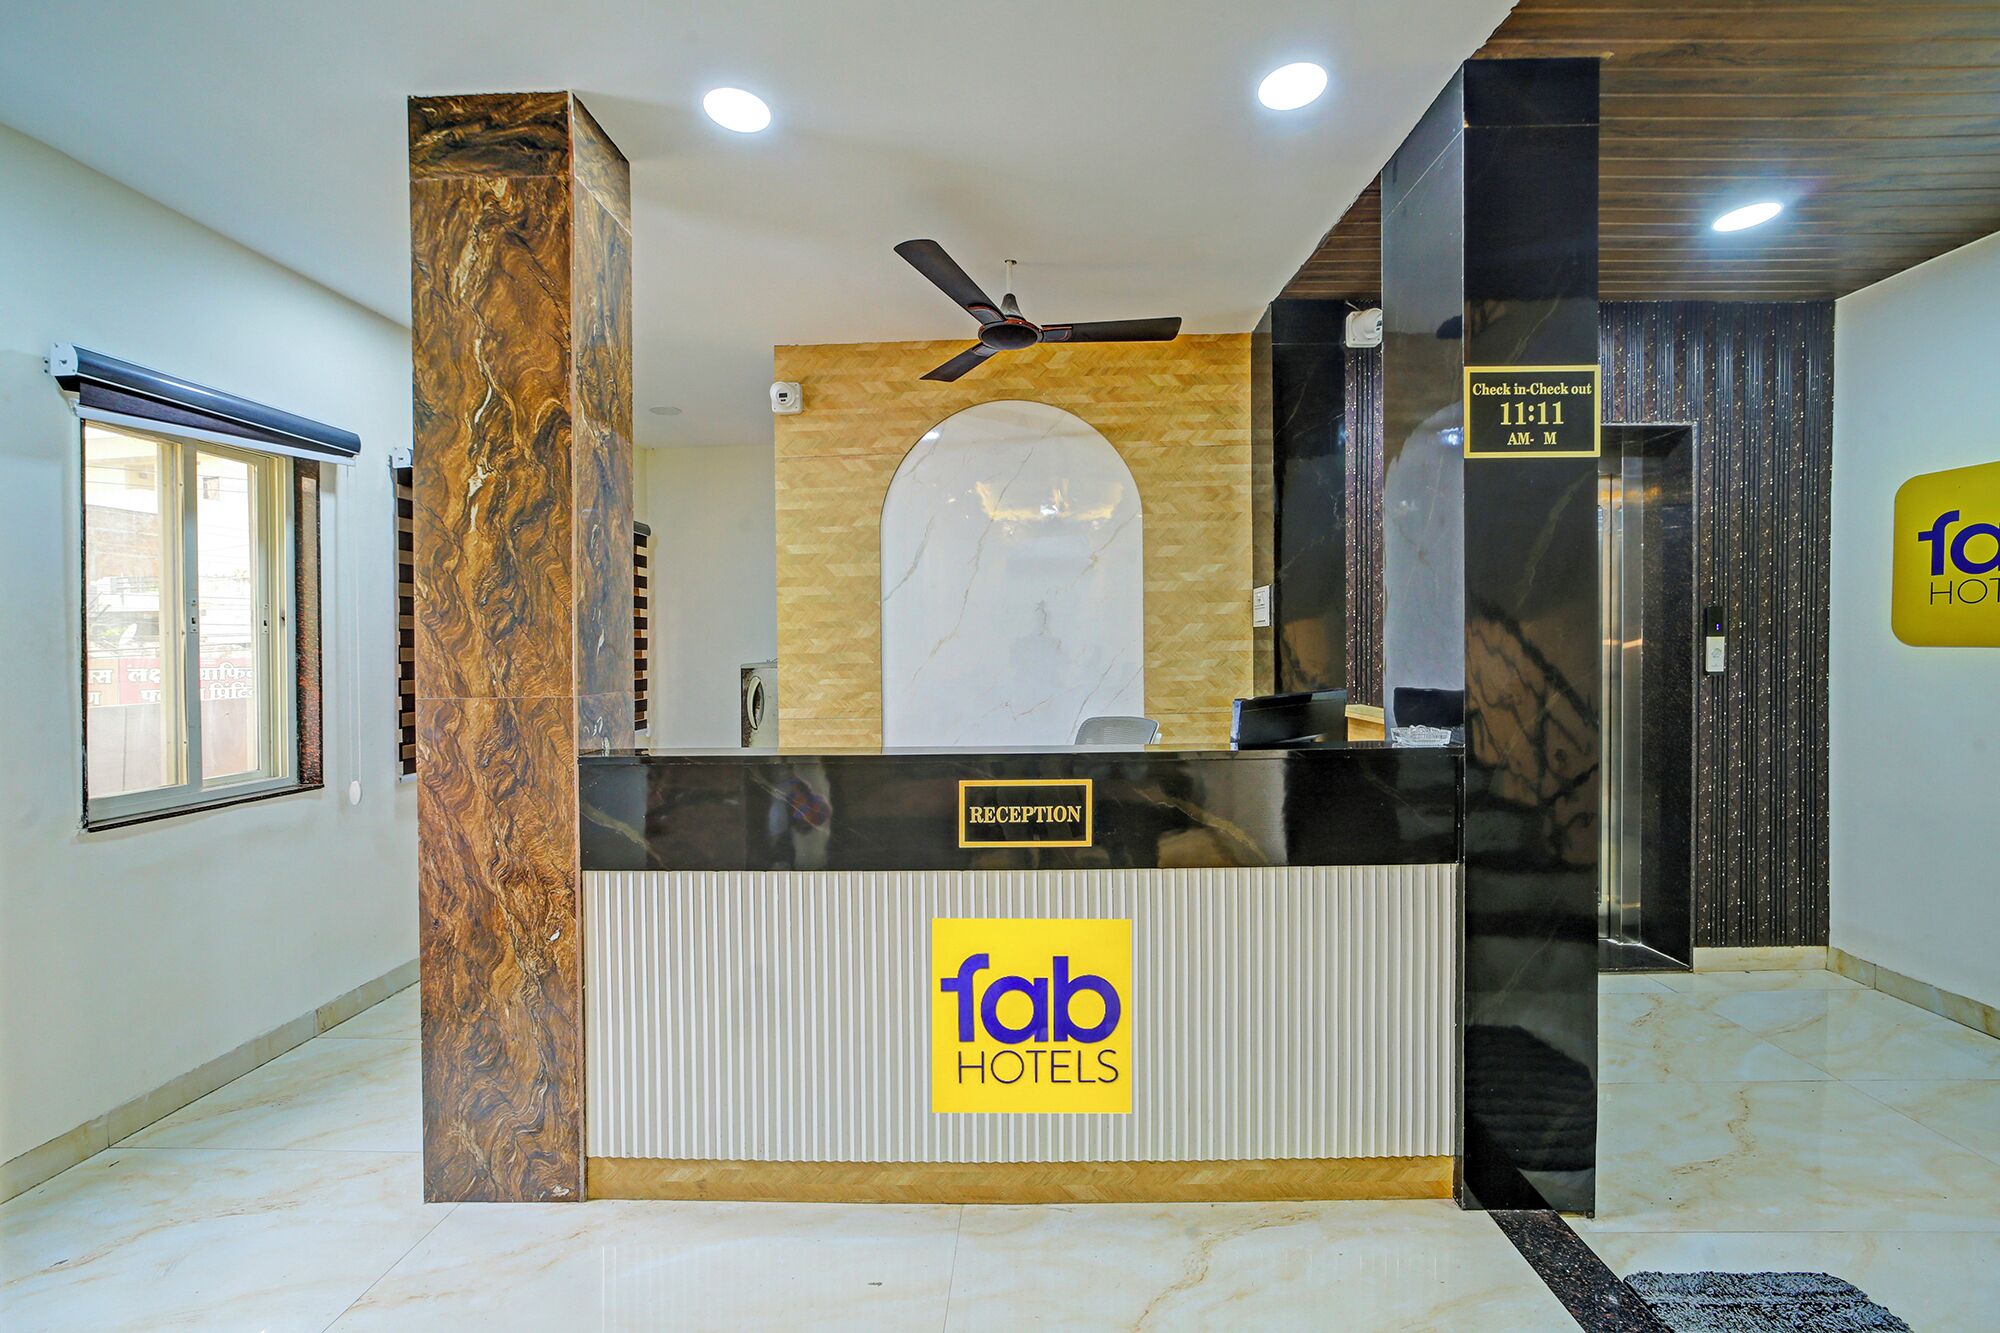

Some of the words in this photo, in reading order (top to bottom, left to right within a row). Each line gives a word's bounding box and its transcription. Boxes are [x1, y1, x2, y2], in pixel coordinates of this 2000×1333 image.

[1472, 383, 1511, 396] Check
[1514, 382, 1569, 395] in-Check
[1571, 383, 1592, 395] out
[1500, 401, 1564, 425] 11:11
[969, 805, 1082, 824] RECEPTION
[940, 952, 1121, 1045] fab
[957, 1049, 1119, 1084] HOTELS
